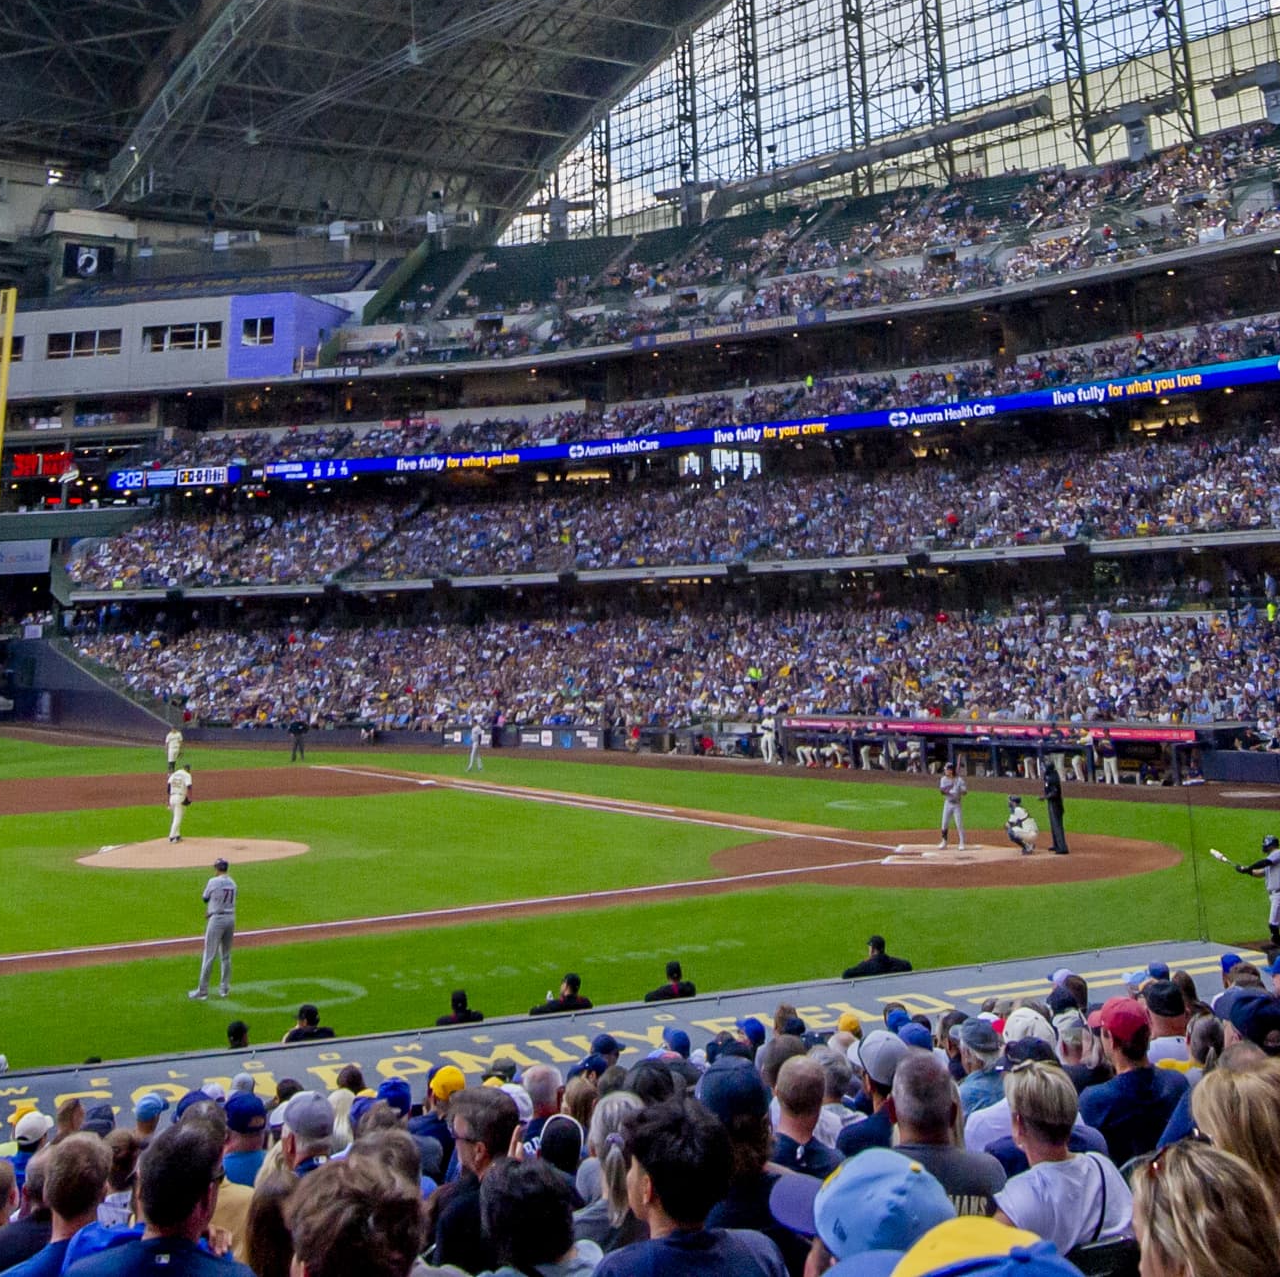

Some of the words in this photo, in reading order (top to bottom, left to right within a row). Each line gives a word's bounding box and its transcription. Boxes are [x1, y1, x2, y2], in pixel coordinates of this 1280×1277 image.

[1052, 391, 1076, 405] live
[1078, 386, 1106, 405] fully
[1107, 383, 1124, 398] for
[1126, 381, 1153, 396] what
[1155, 379, 1176, 396] you
[1177, 373, 1202, 389] love
[909, 410, 943, 425] Aurora
[945, 406, 972, 422] Health
[974, 403, 995, 418] Care
[714, 430, 733, 443] live
[736, 427, 761, 443] fully
[763, 425, 777, 439] for
[779, 425, 800, 439] your
[802, 422, 826, 435] crew
[584, 443, 610, 456] Aurora
[611, 441, 638, 454] Health
[639, 439, 659, 452] Care
[397, 458, 417, 471] live
[419, 457, 444, 471] fully
[446, 456, 460, 469] for
[462, 455, 485, 468] what
[487, 454, 502, 468] you
[502, 452, 519, 464] love
[222, 889, 234, 904] 71
